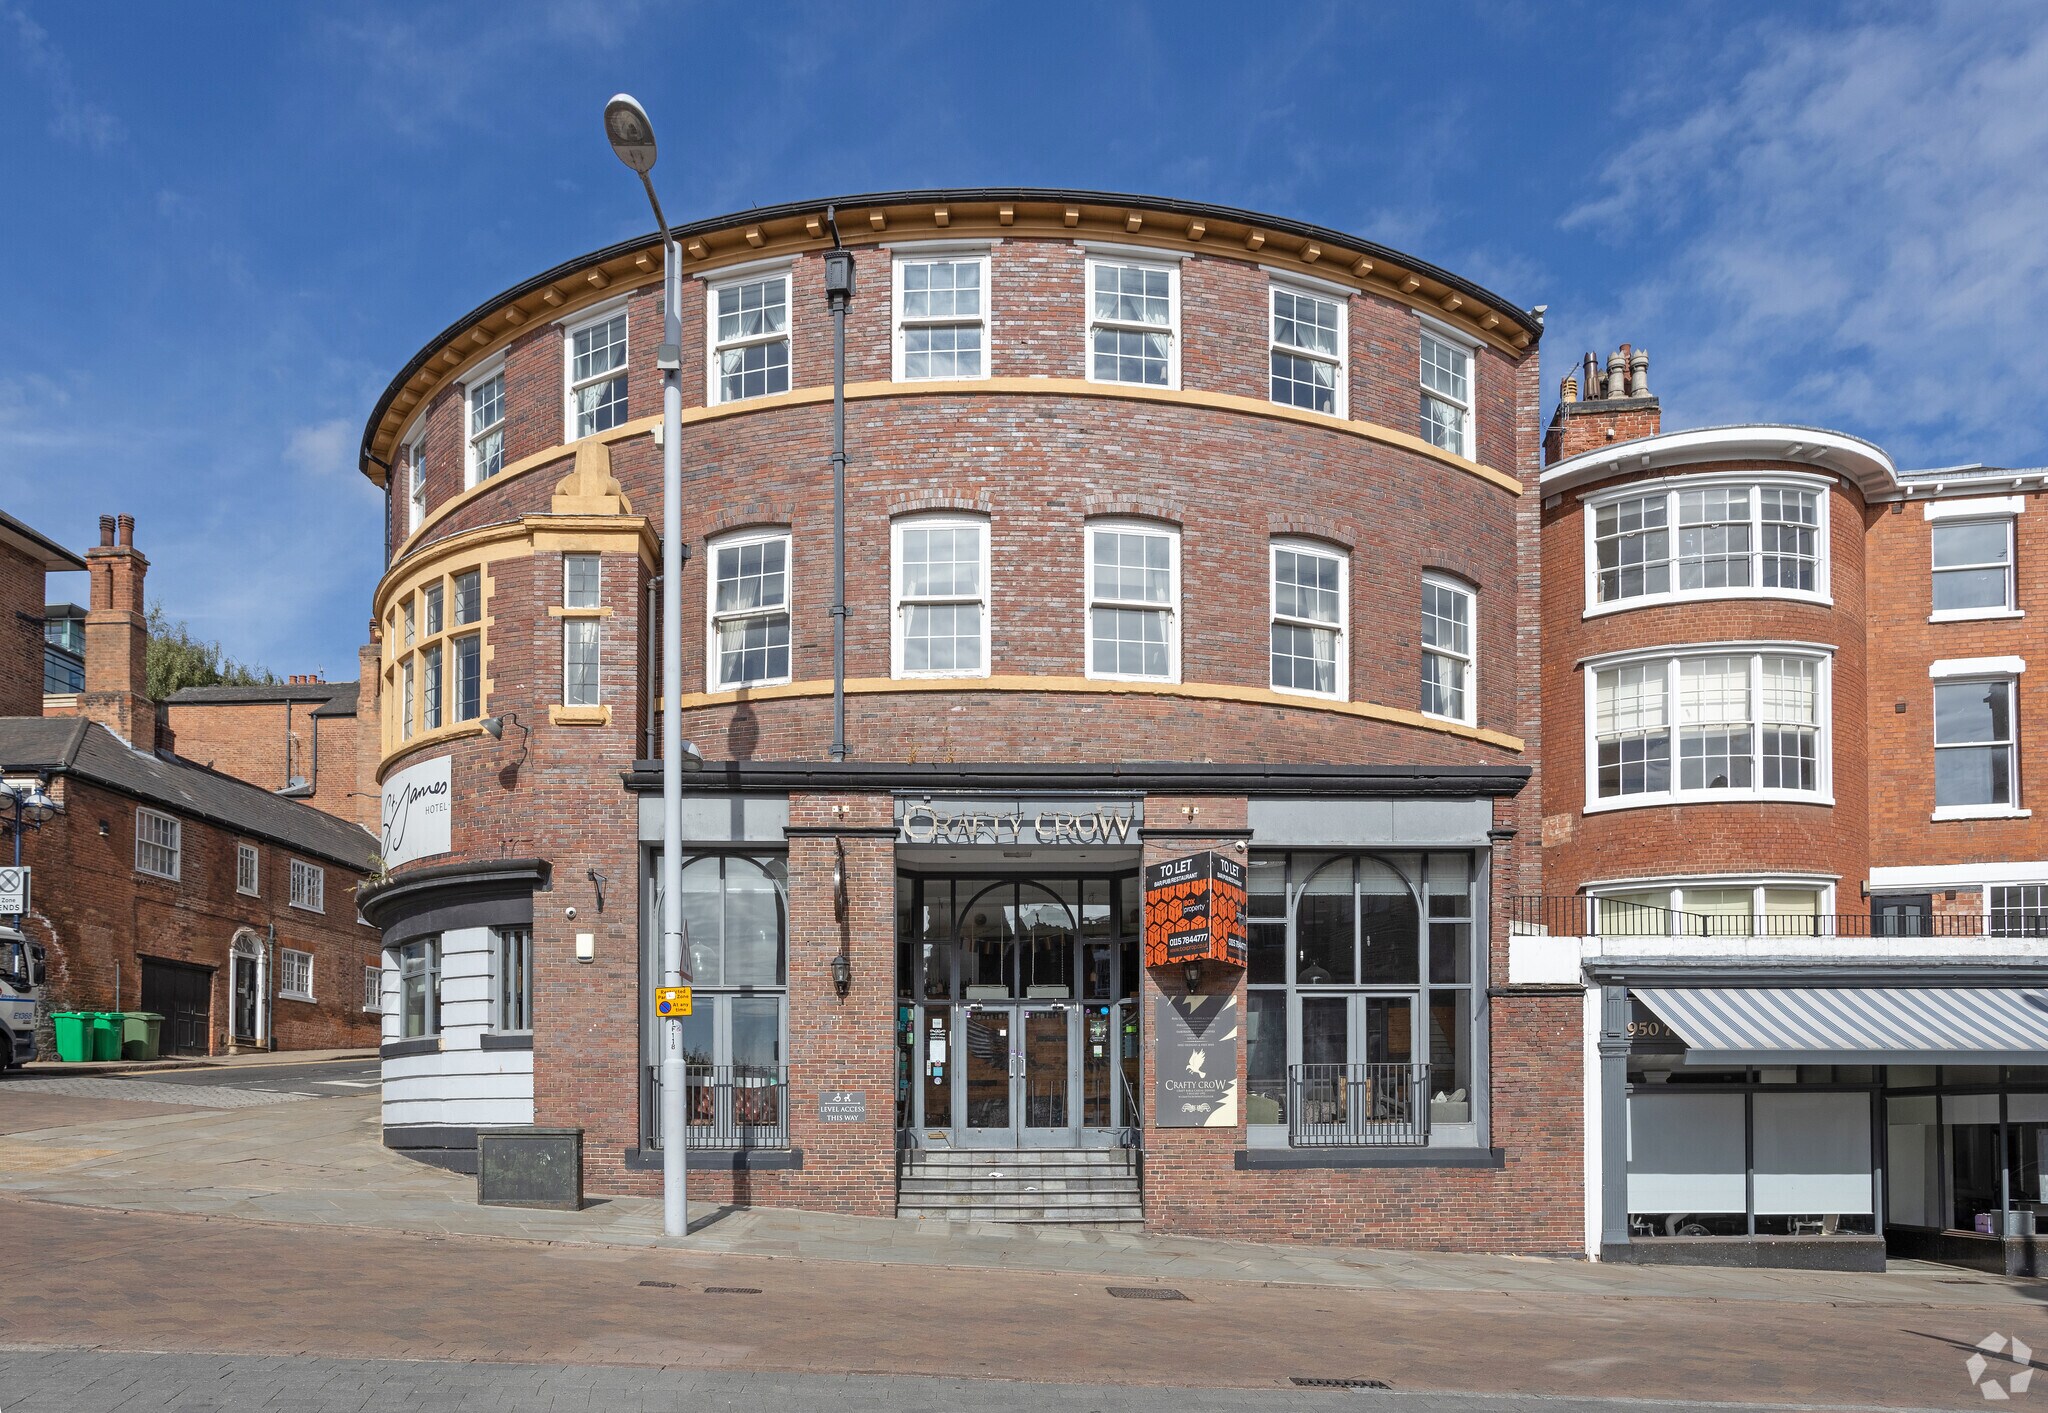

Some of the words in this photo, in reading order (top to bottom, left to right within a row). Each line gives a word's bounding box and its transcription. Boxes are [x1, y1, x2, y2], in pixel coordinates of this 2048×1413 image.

[390, 781, 447, 852] James
[425, 803, 447, 815] HOTEL
[1035, 804, 1134, 839] CROW
[1160, 864, 1173, 877] TO
[1175, 859, 1192, 874] LET
[1220, 859, 1229, 872] TO
[1229, 863, 1239, 877] LET
[1183, 904, 1205, 916] property
[1169, 937, 1181, 947] 0115
[1626, 1021, 1659, 1037] 950
[1165, 1079, 1196, 1091] CRAFTY
[1197, 1079, 1226, 1090] CROW
